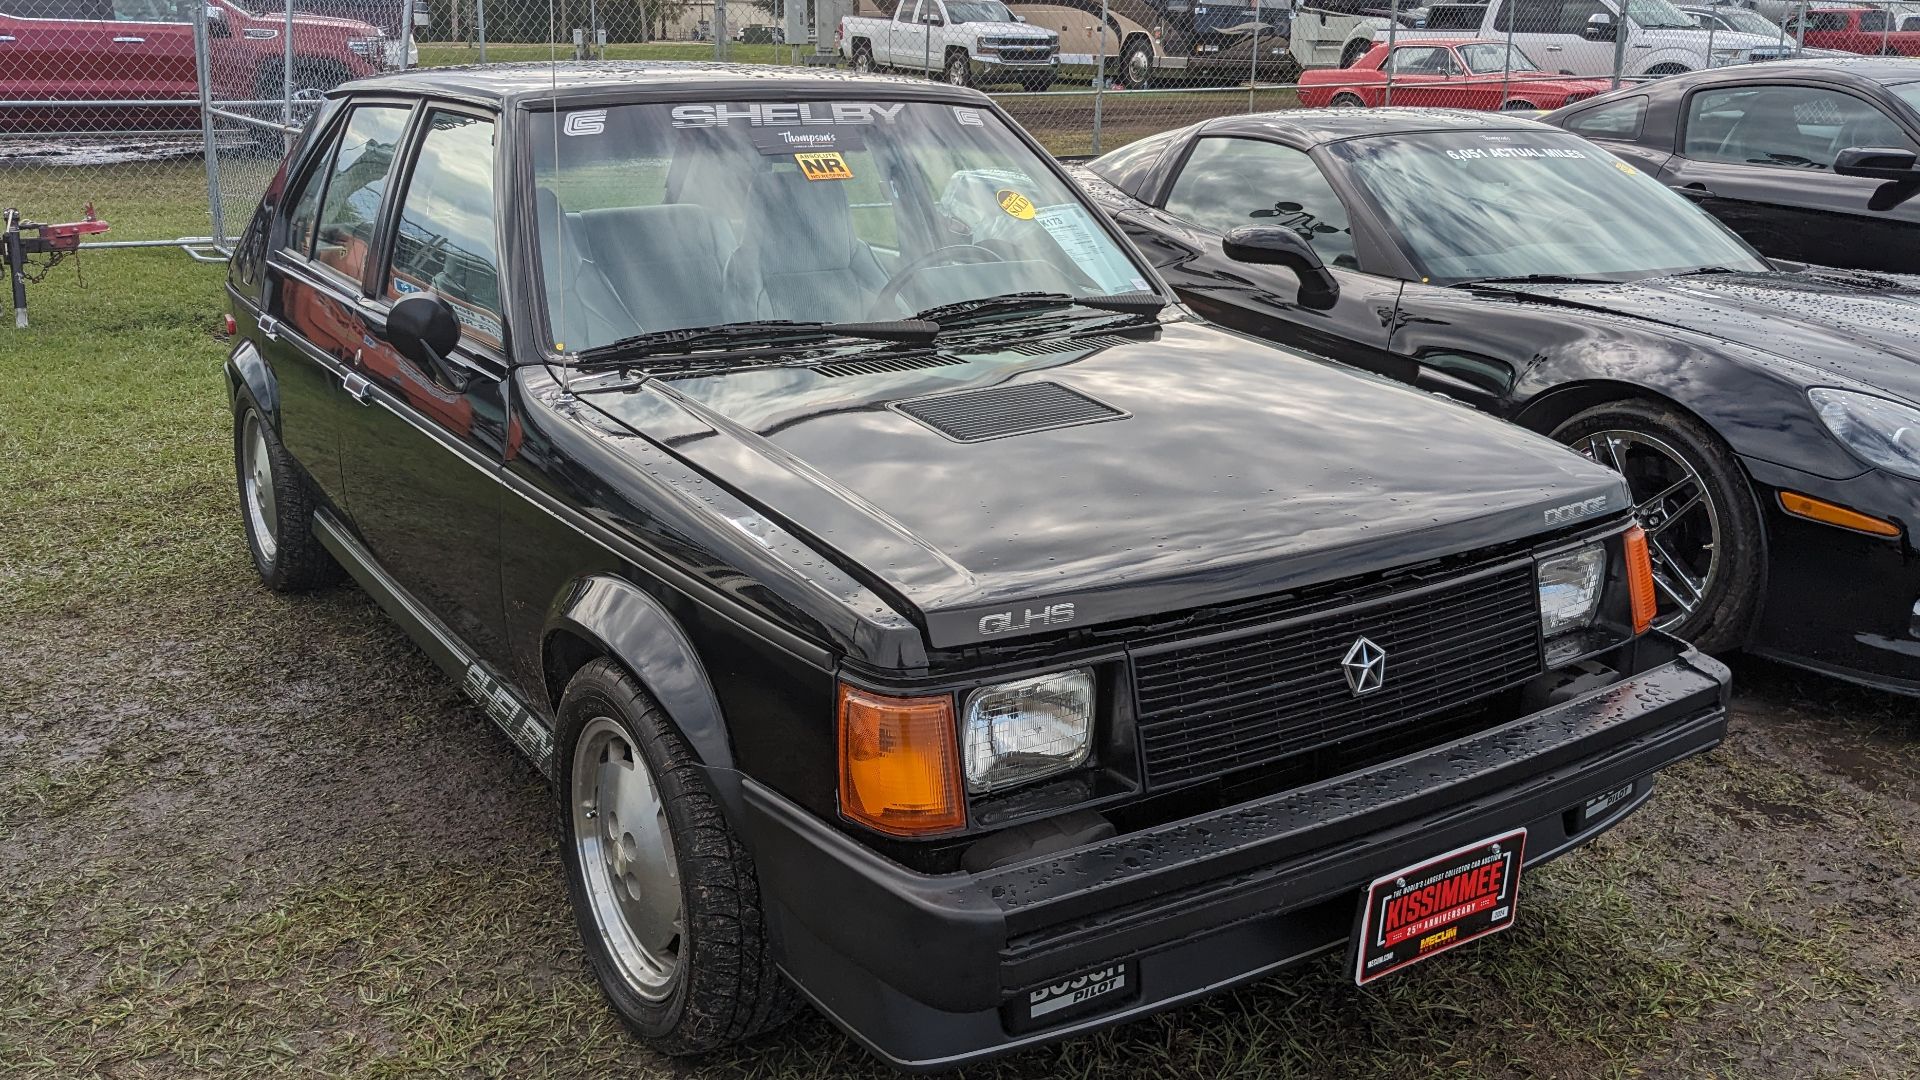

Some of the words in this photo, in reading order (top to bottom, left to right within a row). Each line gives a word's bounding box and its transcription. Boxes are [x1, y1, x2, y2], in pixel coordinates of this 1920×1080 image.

[671, 103, 907, 128] SHELBY
[778, 131, 837, 146] Thompson's
[1446, 149, 1488, 161] 6,051
[1489, 147, 1544, 157] ACTUAL
[1542, 148, 1586, 159] MILES
[802, 159, 846, 174] NR
[1010, 197, 1028, 216] SOLD
[1041, 217, 1063, 227] K173
[1544, 495, 1606, 526] DODGE
[979, 602, 1075, 635] GLHS
[1386, 861, 1504, 932] KISSIMMEE
[1423, 903, 1476, 929] ANNIVERSARY
[1420, 927, 1457, 949] MECUM
[1073, 979, 1118, 1003] PILOT
